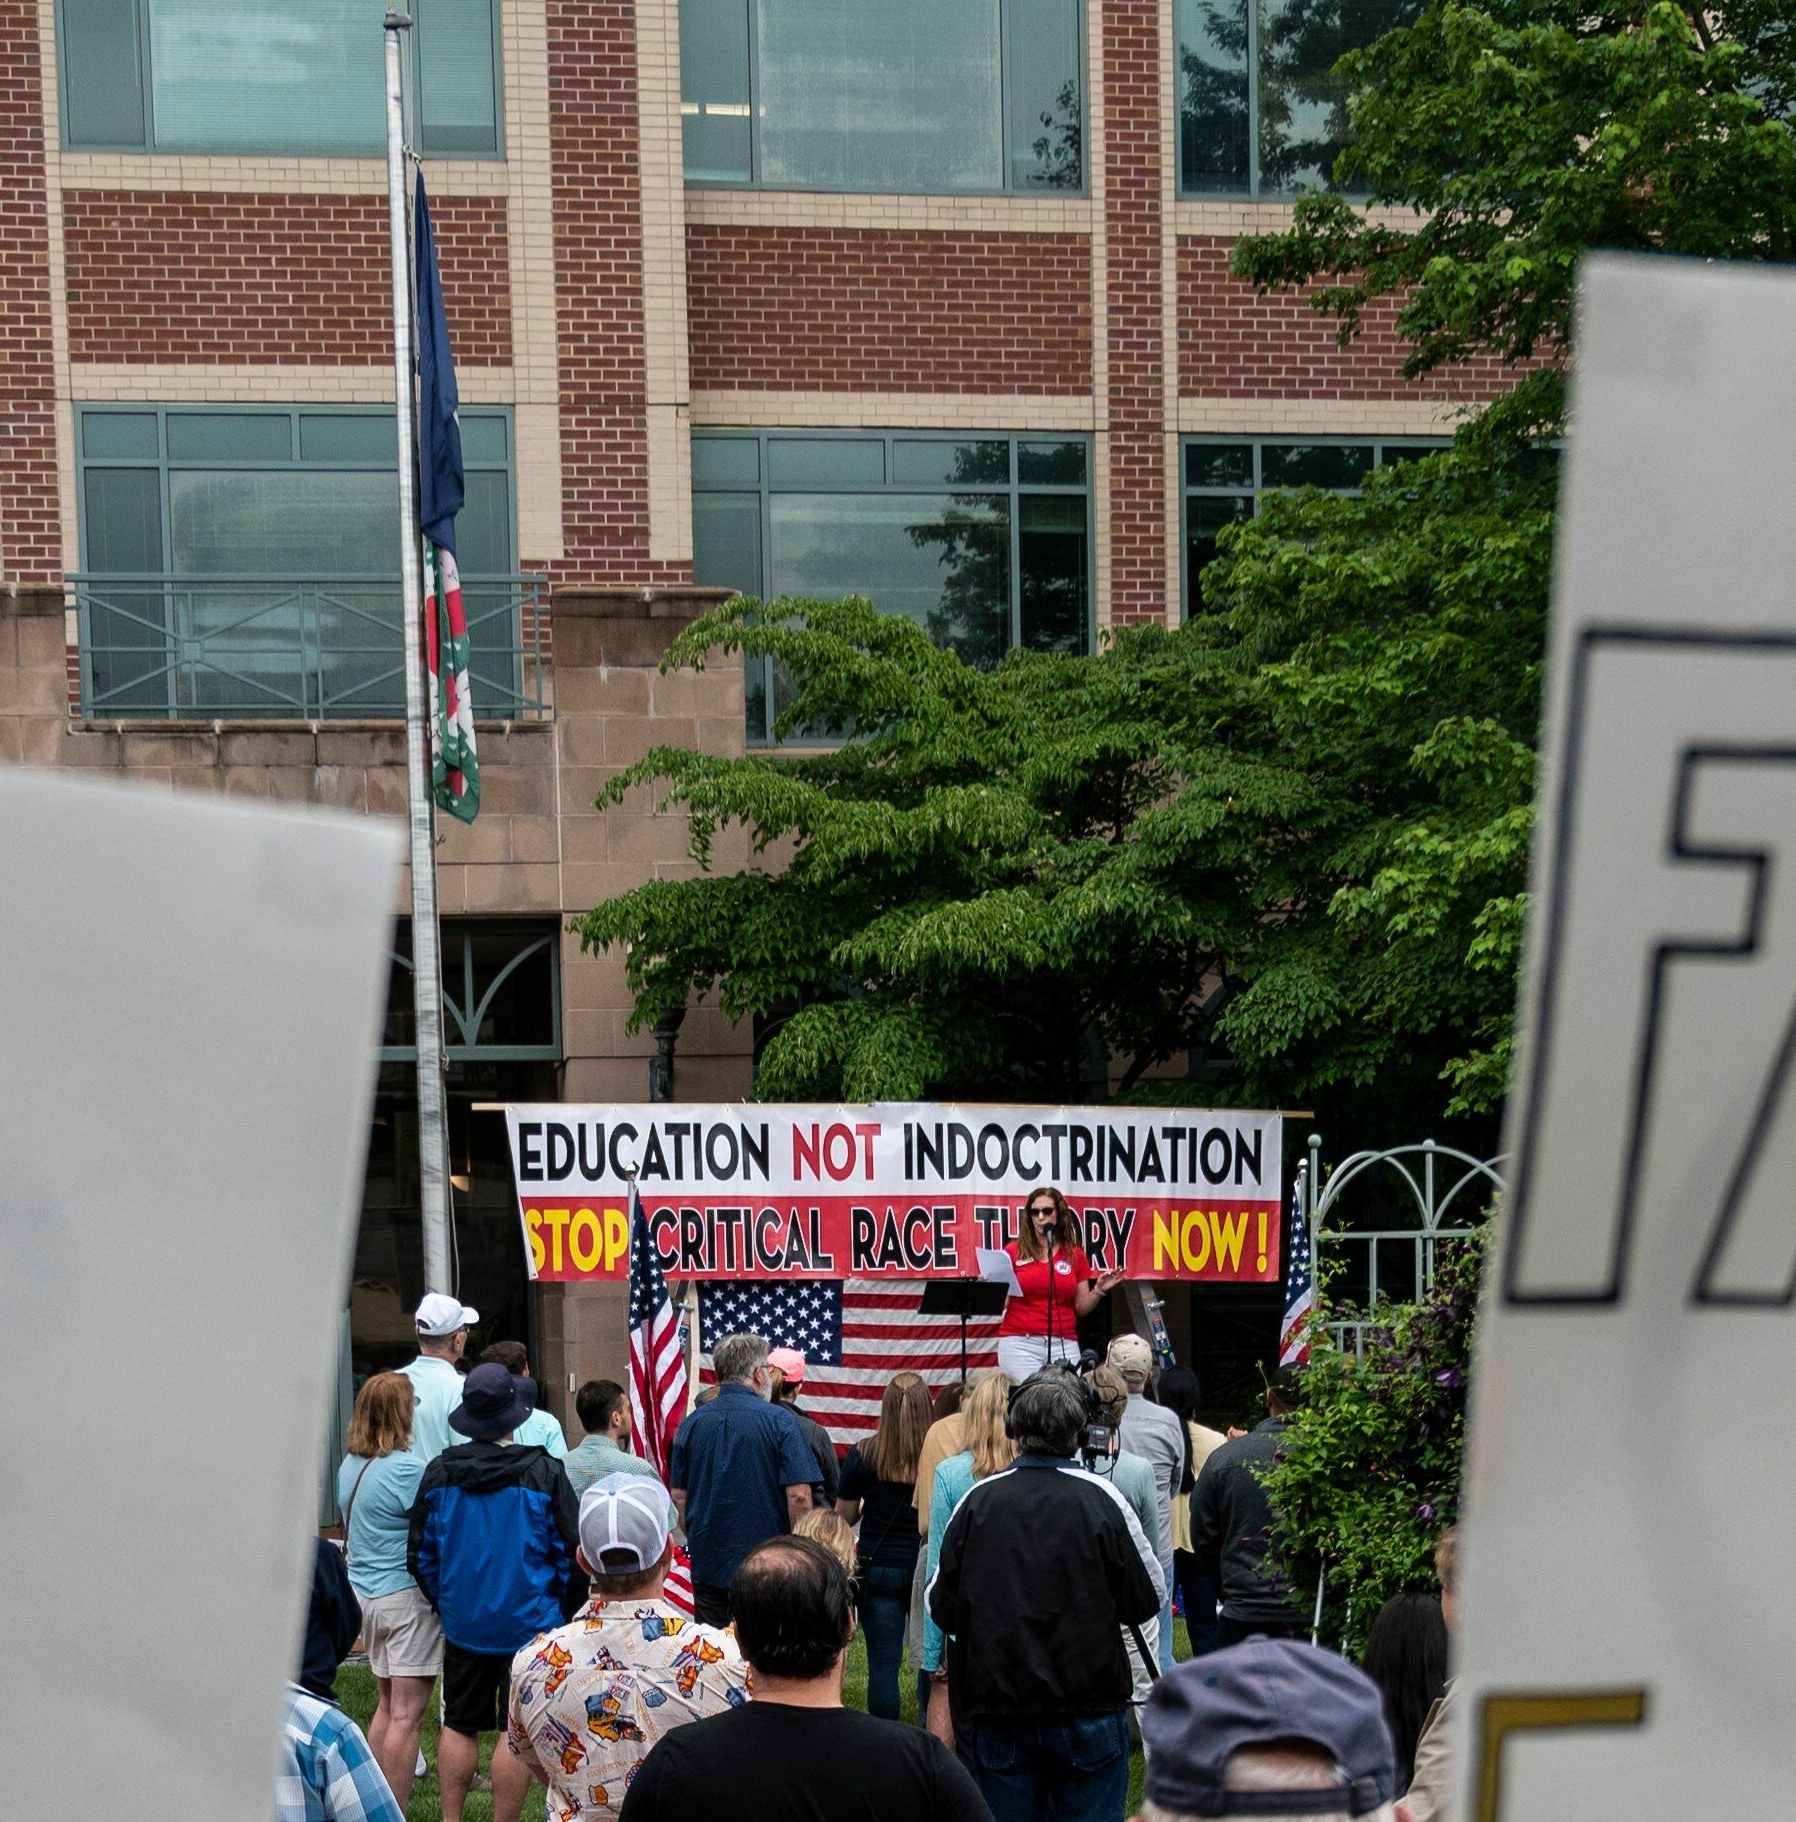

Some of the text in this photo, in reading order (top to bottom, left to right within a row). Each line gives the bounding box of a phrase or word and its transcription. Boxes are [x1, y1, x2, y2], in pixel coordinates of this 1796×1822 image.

[517, 1121, 1263, 1187] EDUCATION NOT INDOCTRINATION
[523, 1207, 629, 1273] STOP
[648, 1206, 835, 1273] CRITICAL
[851, 1205, 959, 1272] RACE
[973, 1205, 1137, 1272] THRY
